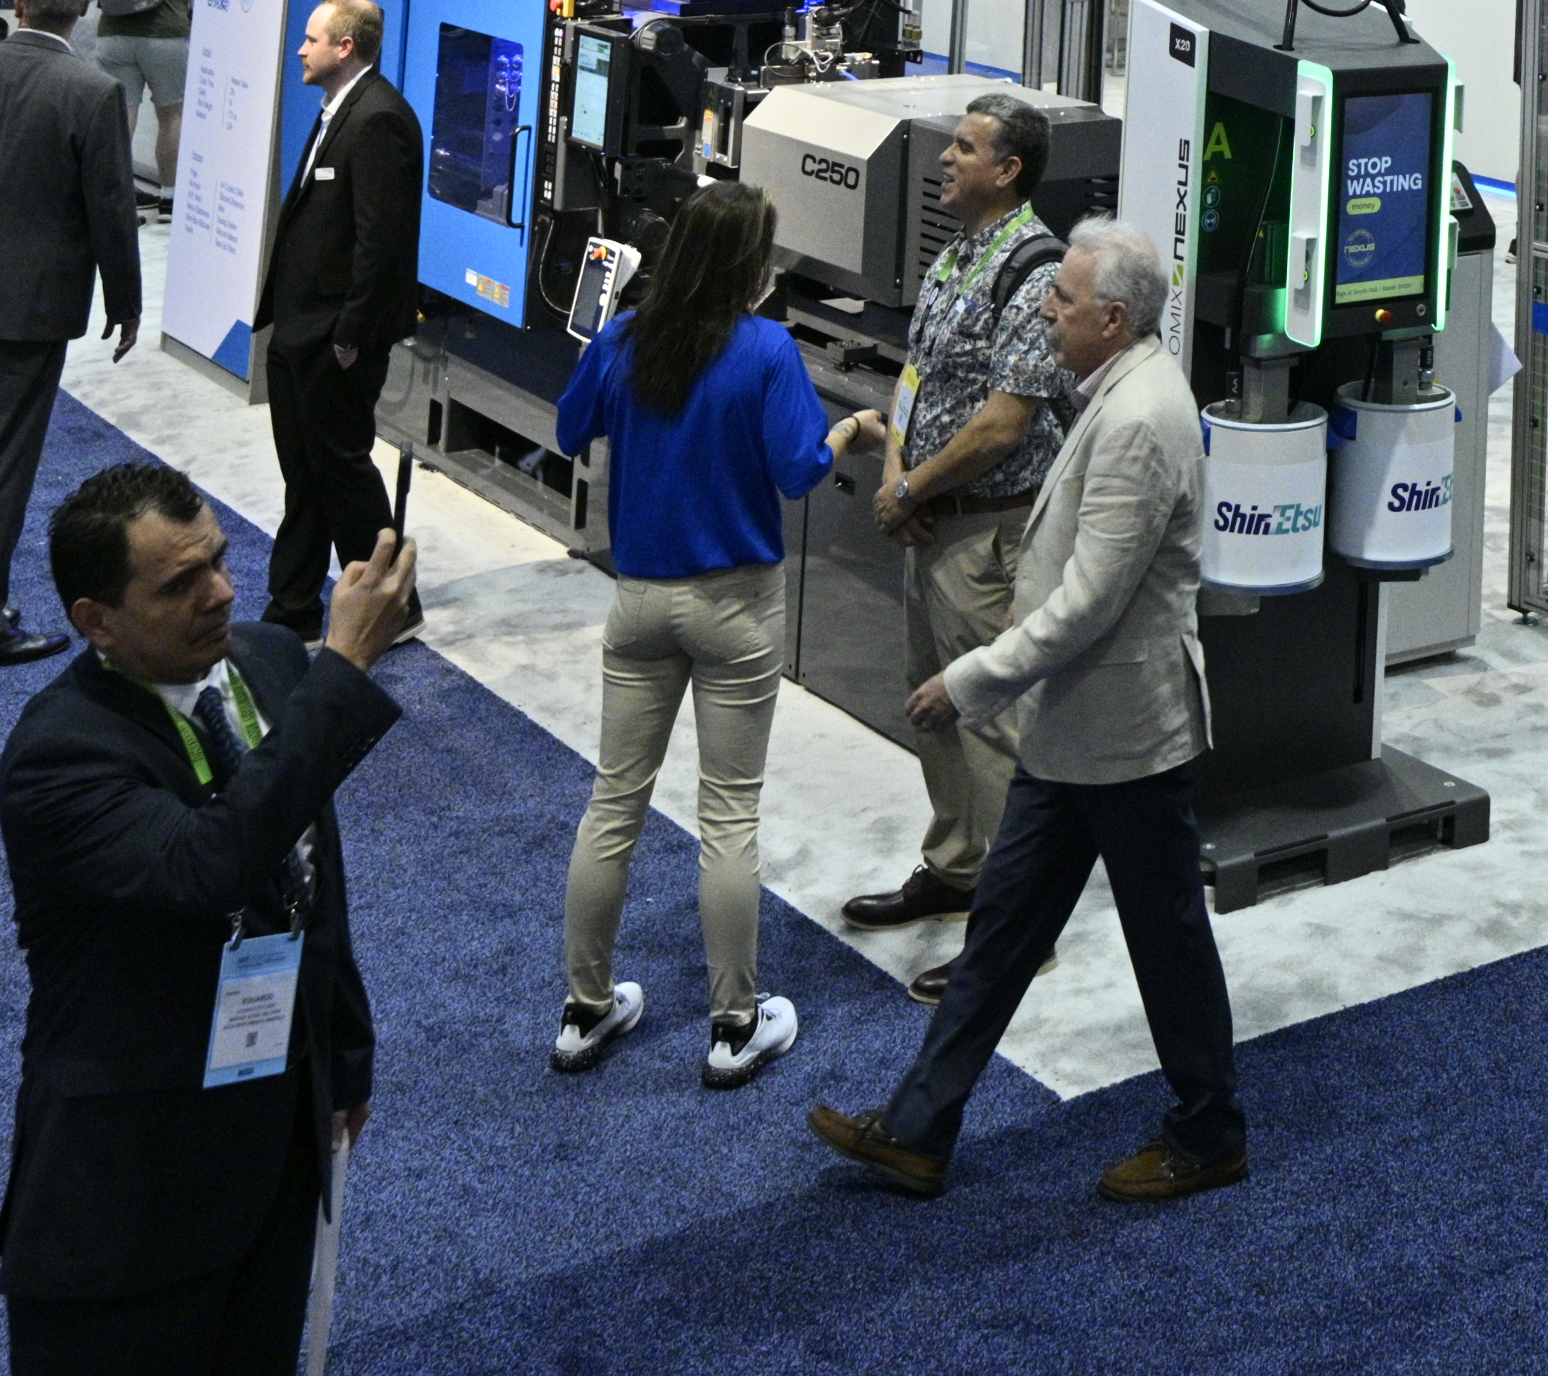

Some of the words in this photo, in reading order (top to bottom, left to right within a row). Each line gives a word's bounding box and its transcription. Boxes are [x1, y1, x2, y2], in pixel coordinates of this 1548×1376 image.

[1175, 38, 1190, 51] X20
[1203, 121, 1232, 161] A
[801, 153, 860, 190] C250
[1348, 156, 1392, 176] STOP
[1347, 172, 1422, 196] WASTING
[1351, 201, 1375, 212] money
